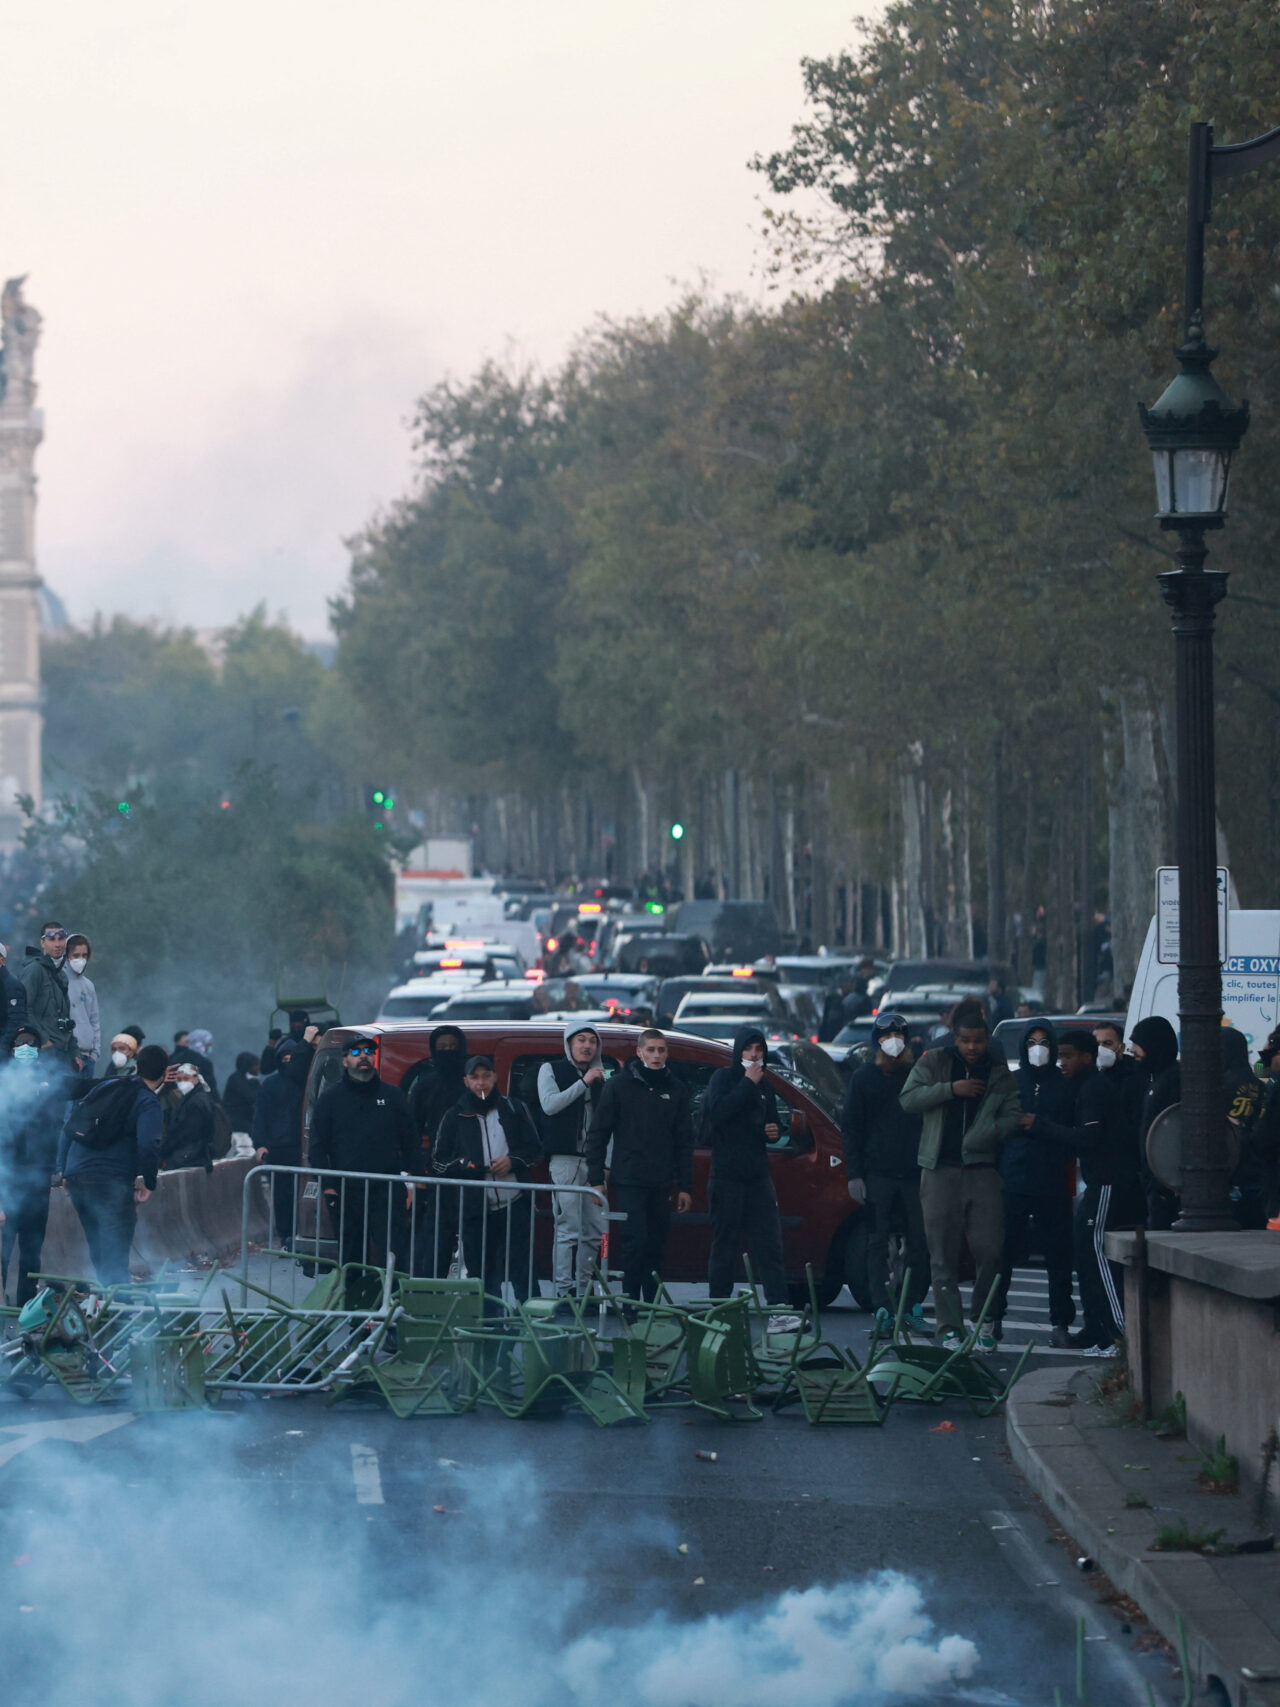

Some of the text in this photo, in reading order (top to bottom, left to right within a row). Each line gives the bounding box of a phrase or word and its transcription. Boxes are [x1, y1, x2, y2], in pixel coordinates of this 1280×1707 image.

[1250, 958, 1280, 972] OXY
[1226, 979, 1276, 989] clic, toutes
[1222, 993, 1265, 1004] simplifier
[1267, 994, 1276, 1003] le
